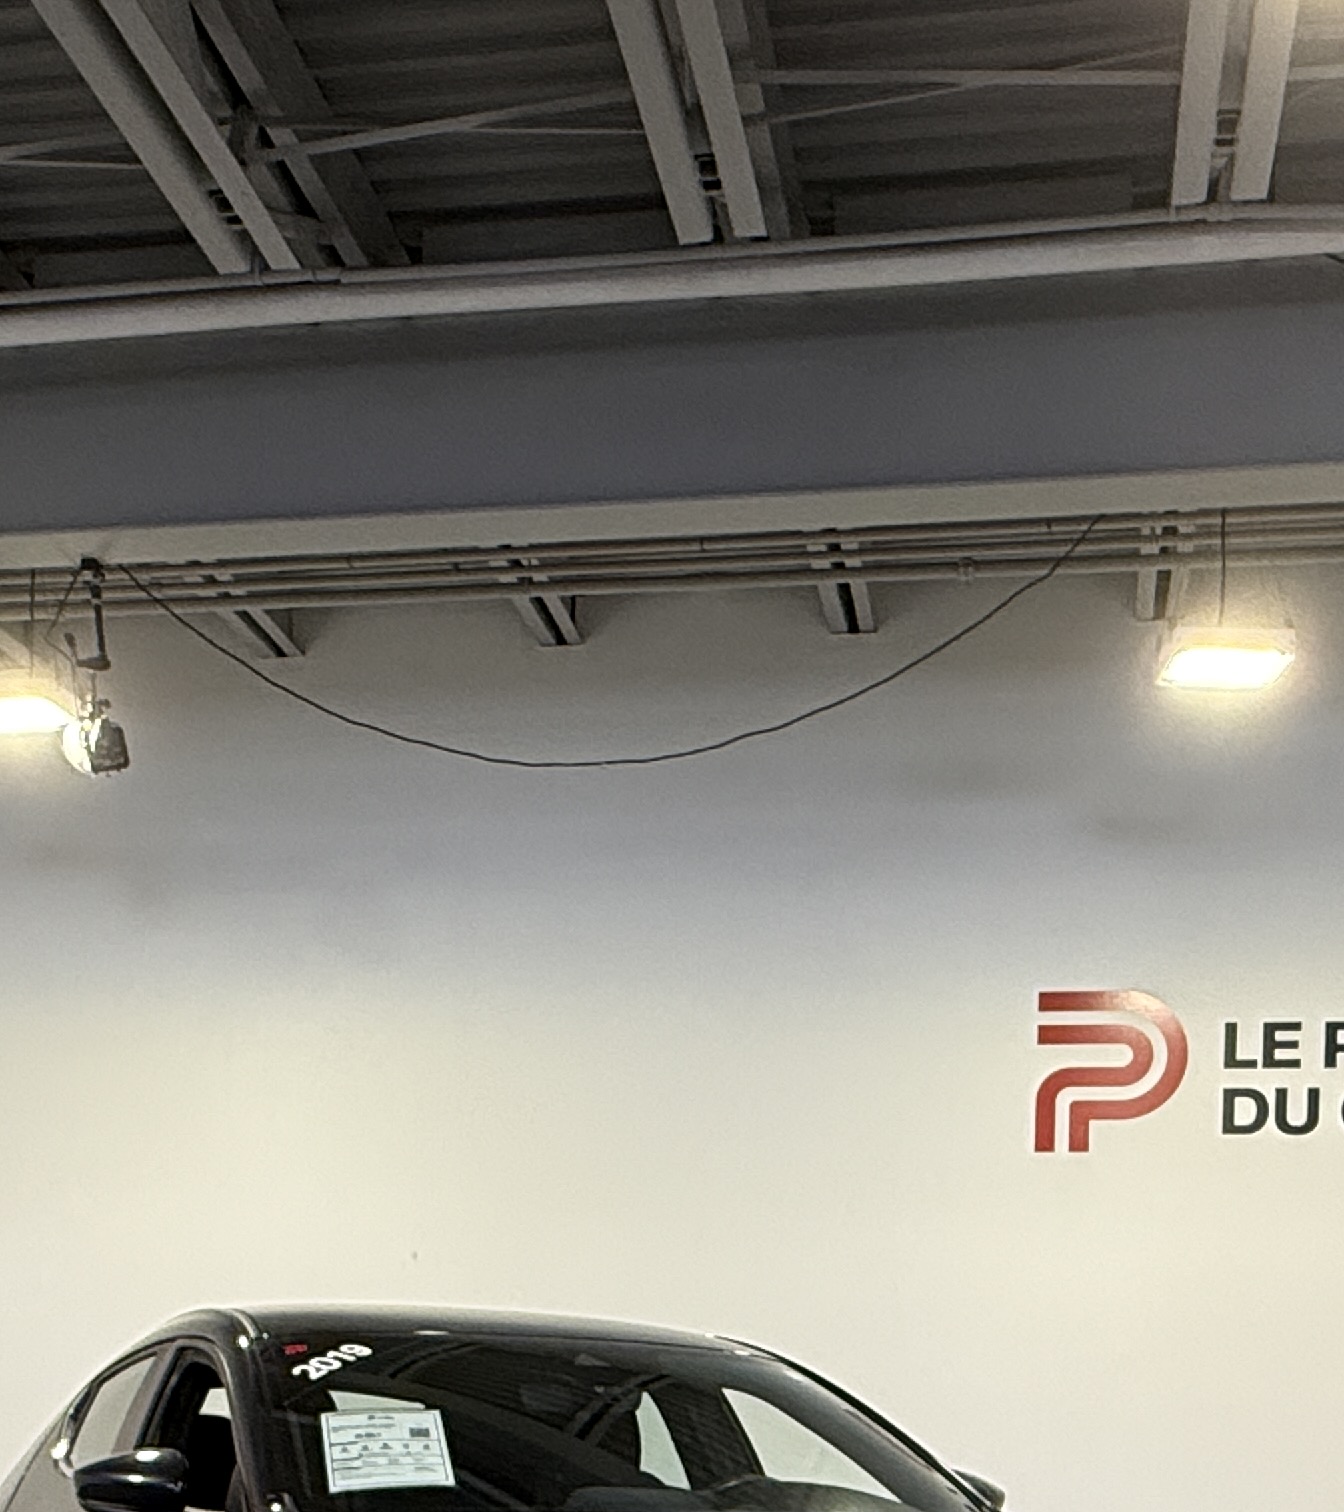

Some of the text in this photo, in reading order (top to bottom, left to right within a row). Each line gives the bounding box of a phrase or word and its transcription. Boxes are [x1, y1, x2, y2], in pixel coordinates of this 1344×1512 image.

[1223, 1021, 1302, 1069] LE
[1221, 1087, 1321, 1135] DU
[291, 1343, 373, 1381] 2019
